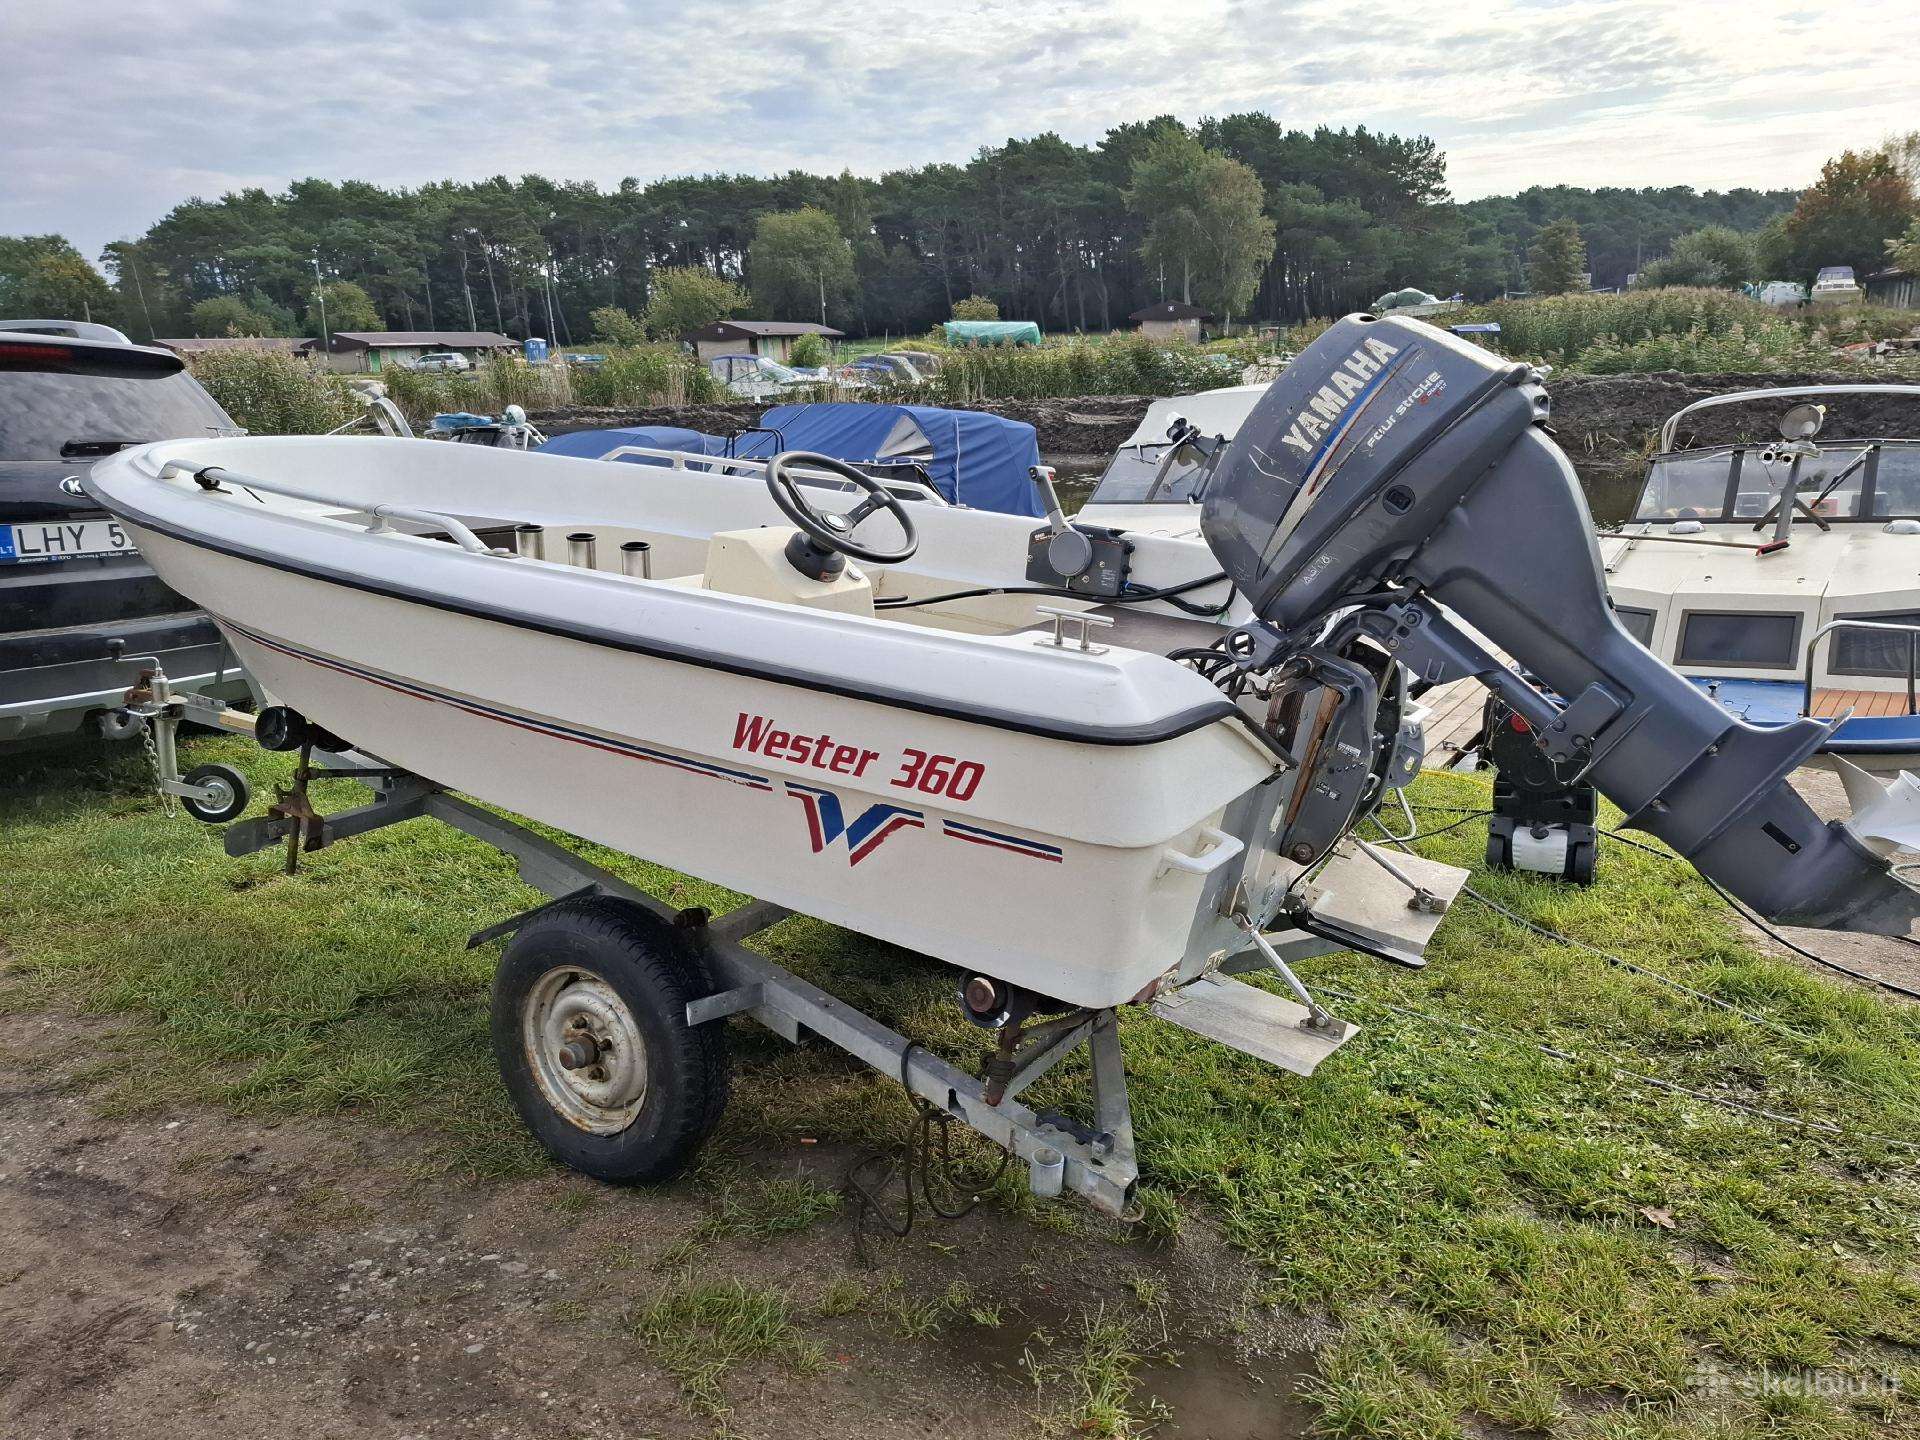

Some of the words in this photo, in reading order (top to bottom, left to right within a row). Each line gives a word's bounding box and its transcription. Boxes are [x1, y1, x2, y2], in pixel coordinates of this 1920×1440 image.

[1282, 338, 1399, 452] YAMAHA
[0, 545, 13, 554] LT
[17, 524, 85, 555] LHY
[732, 712, 880, 778] Wester
[890, 747, 986, 802] 360
